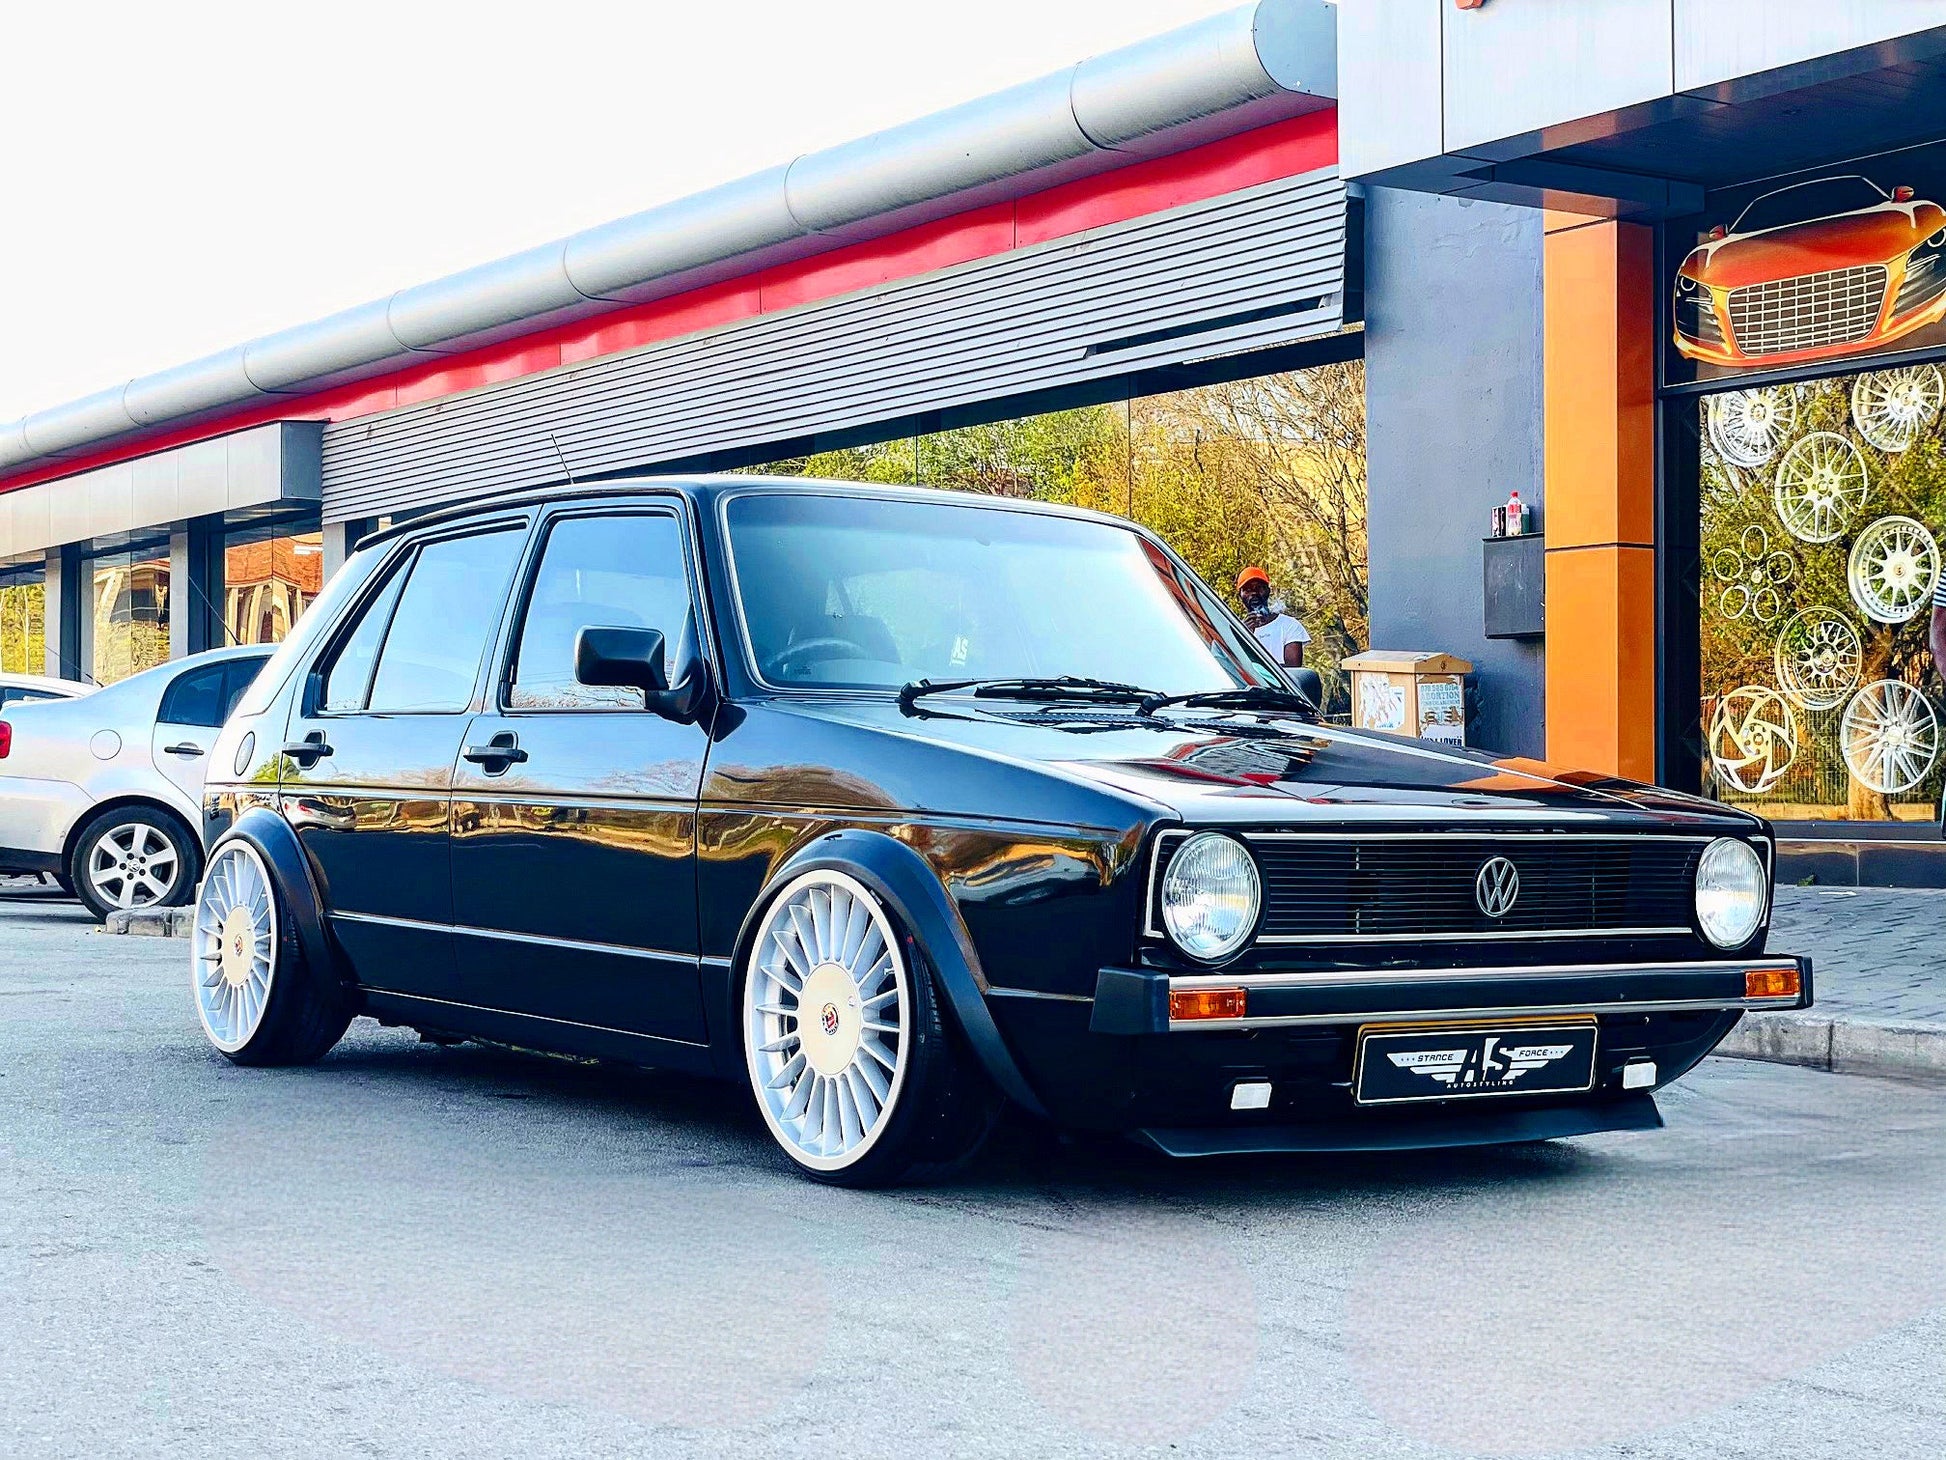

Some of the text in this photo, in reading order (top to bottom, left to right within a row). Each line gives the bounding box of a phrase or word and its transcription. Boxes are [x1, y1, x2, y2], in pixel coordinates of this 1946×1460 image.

[1421, 691, 1460, 700] ABORTION
[1417, 1049, 1549, 1063] STANCE FORCE
[1446, 1080, 1514, 1089] AUTOSTYLING
